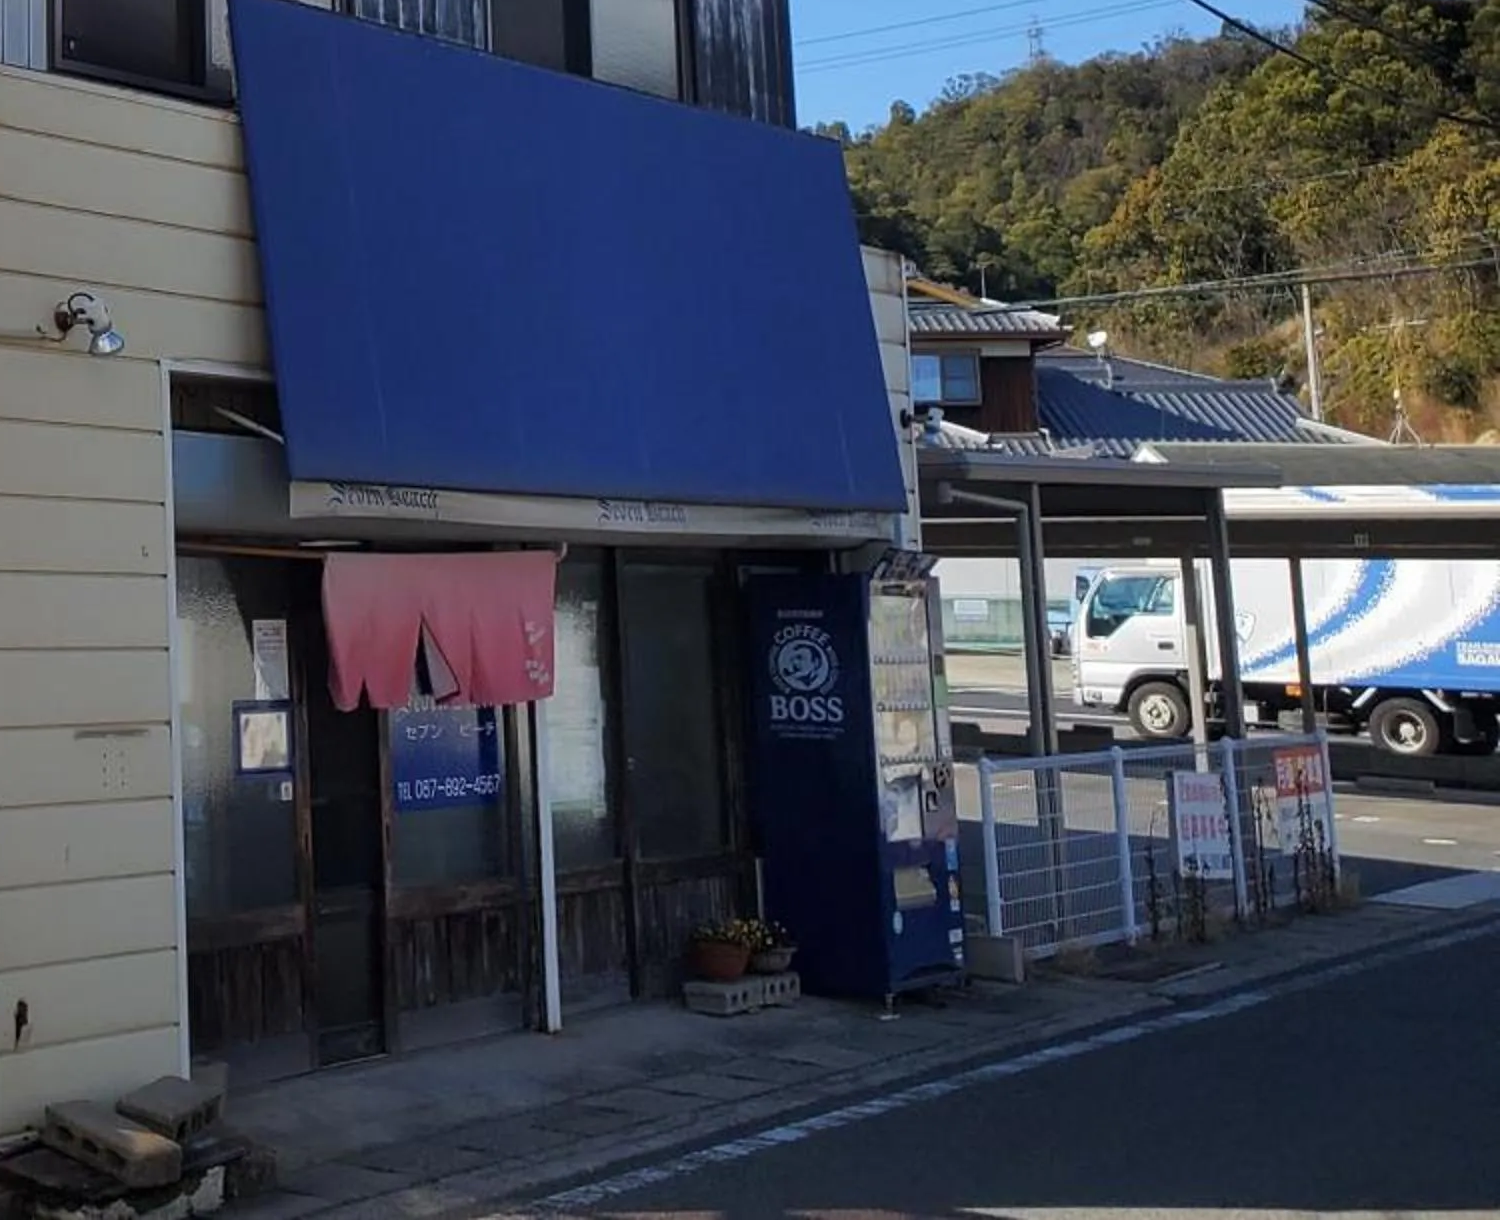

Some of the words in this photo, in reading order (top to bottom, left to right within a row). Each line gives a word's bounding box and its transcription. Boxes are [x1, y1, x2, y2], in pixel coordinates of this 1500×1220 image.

[773, 624, 831, 646] COFFEE
[770, 694, 844, 722] BOSS
[405, 723, 443, 741] セブン
